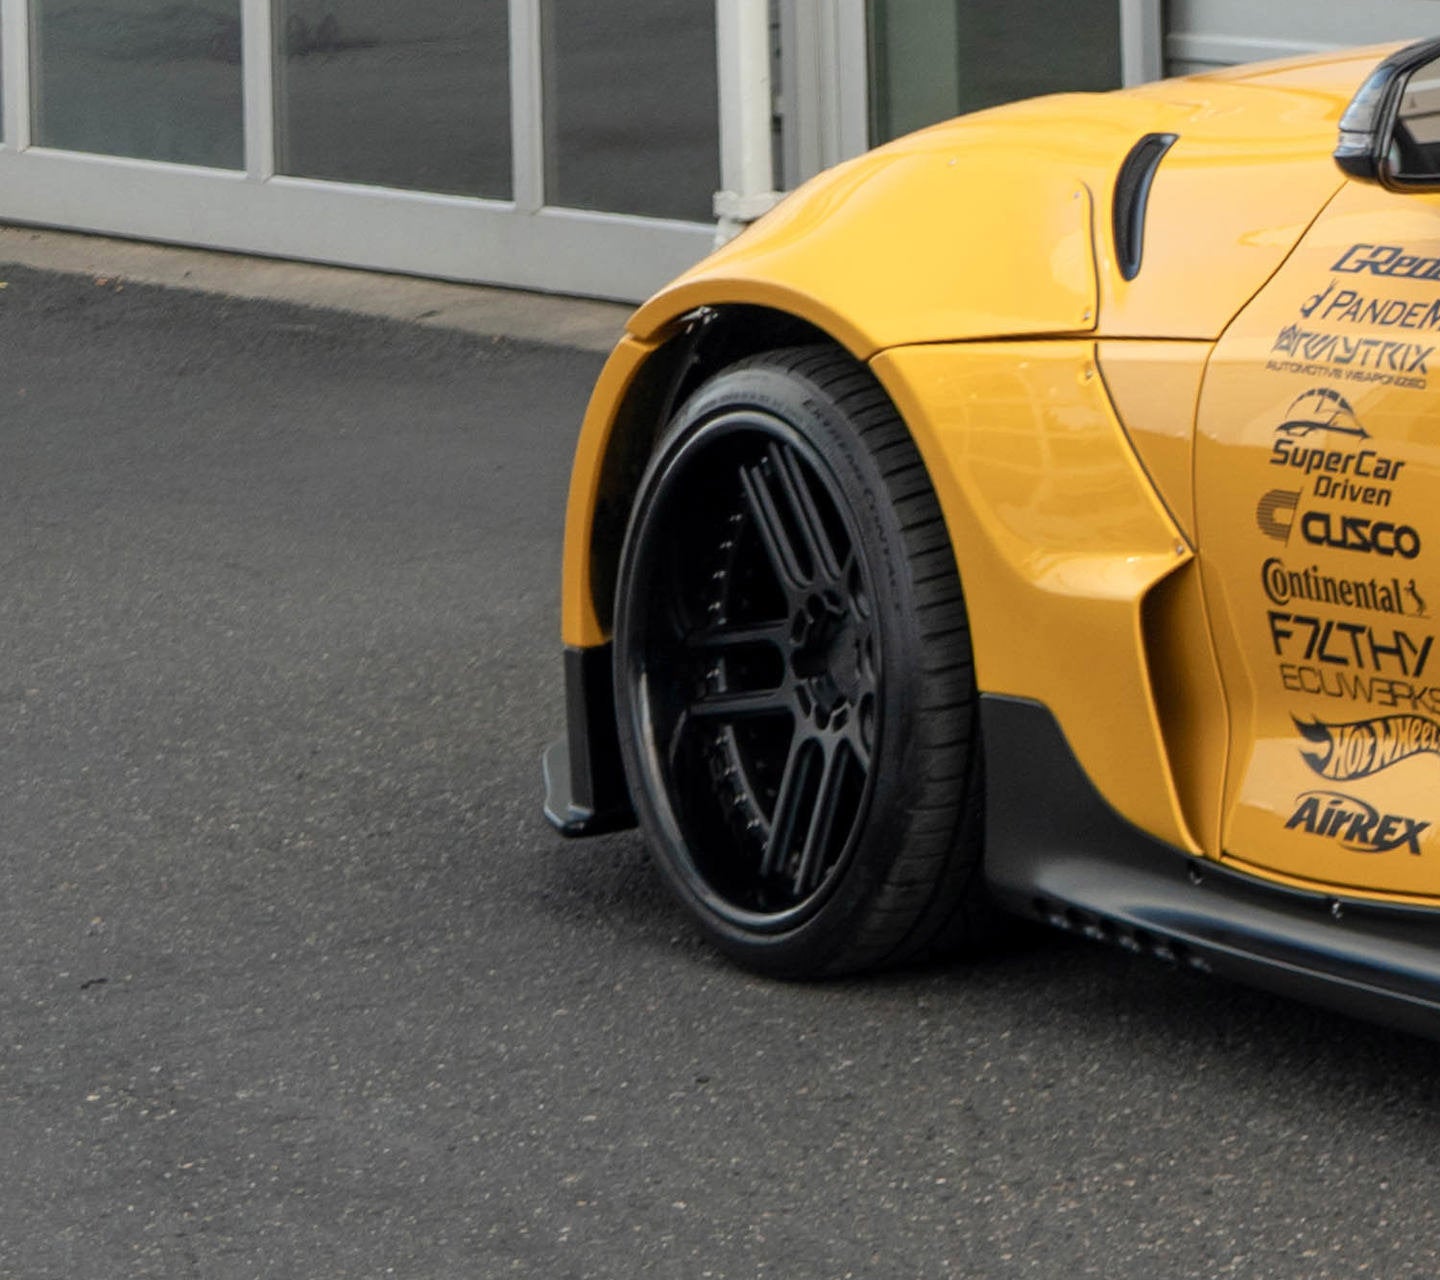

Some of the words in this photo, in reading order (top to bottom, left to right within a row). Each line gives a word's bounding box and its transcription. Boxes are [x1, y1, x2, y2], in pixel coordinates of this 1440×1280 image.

[1265, 360, 1342, 379] AUTOMOTIVE
[1270, 438, 1406, 481] SuperCar
[1313, 475, 1392, 507] Driven
[1262, 557, 1404, 615] Continental
